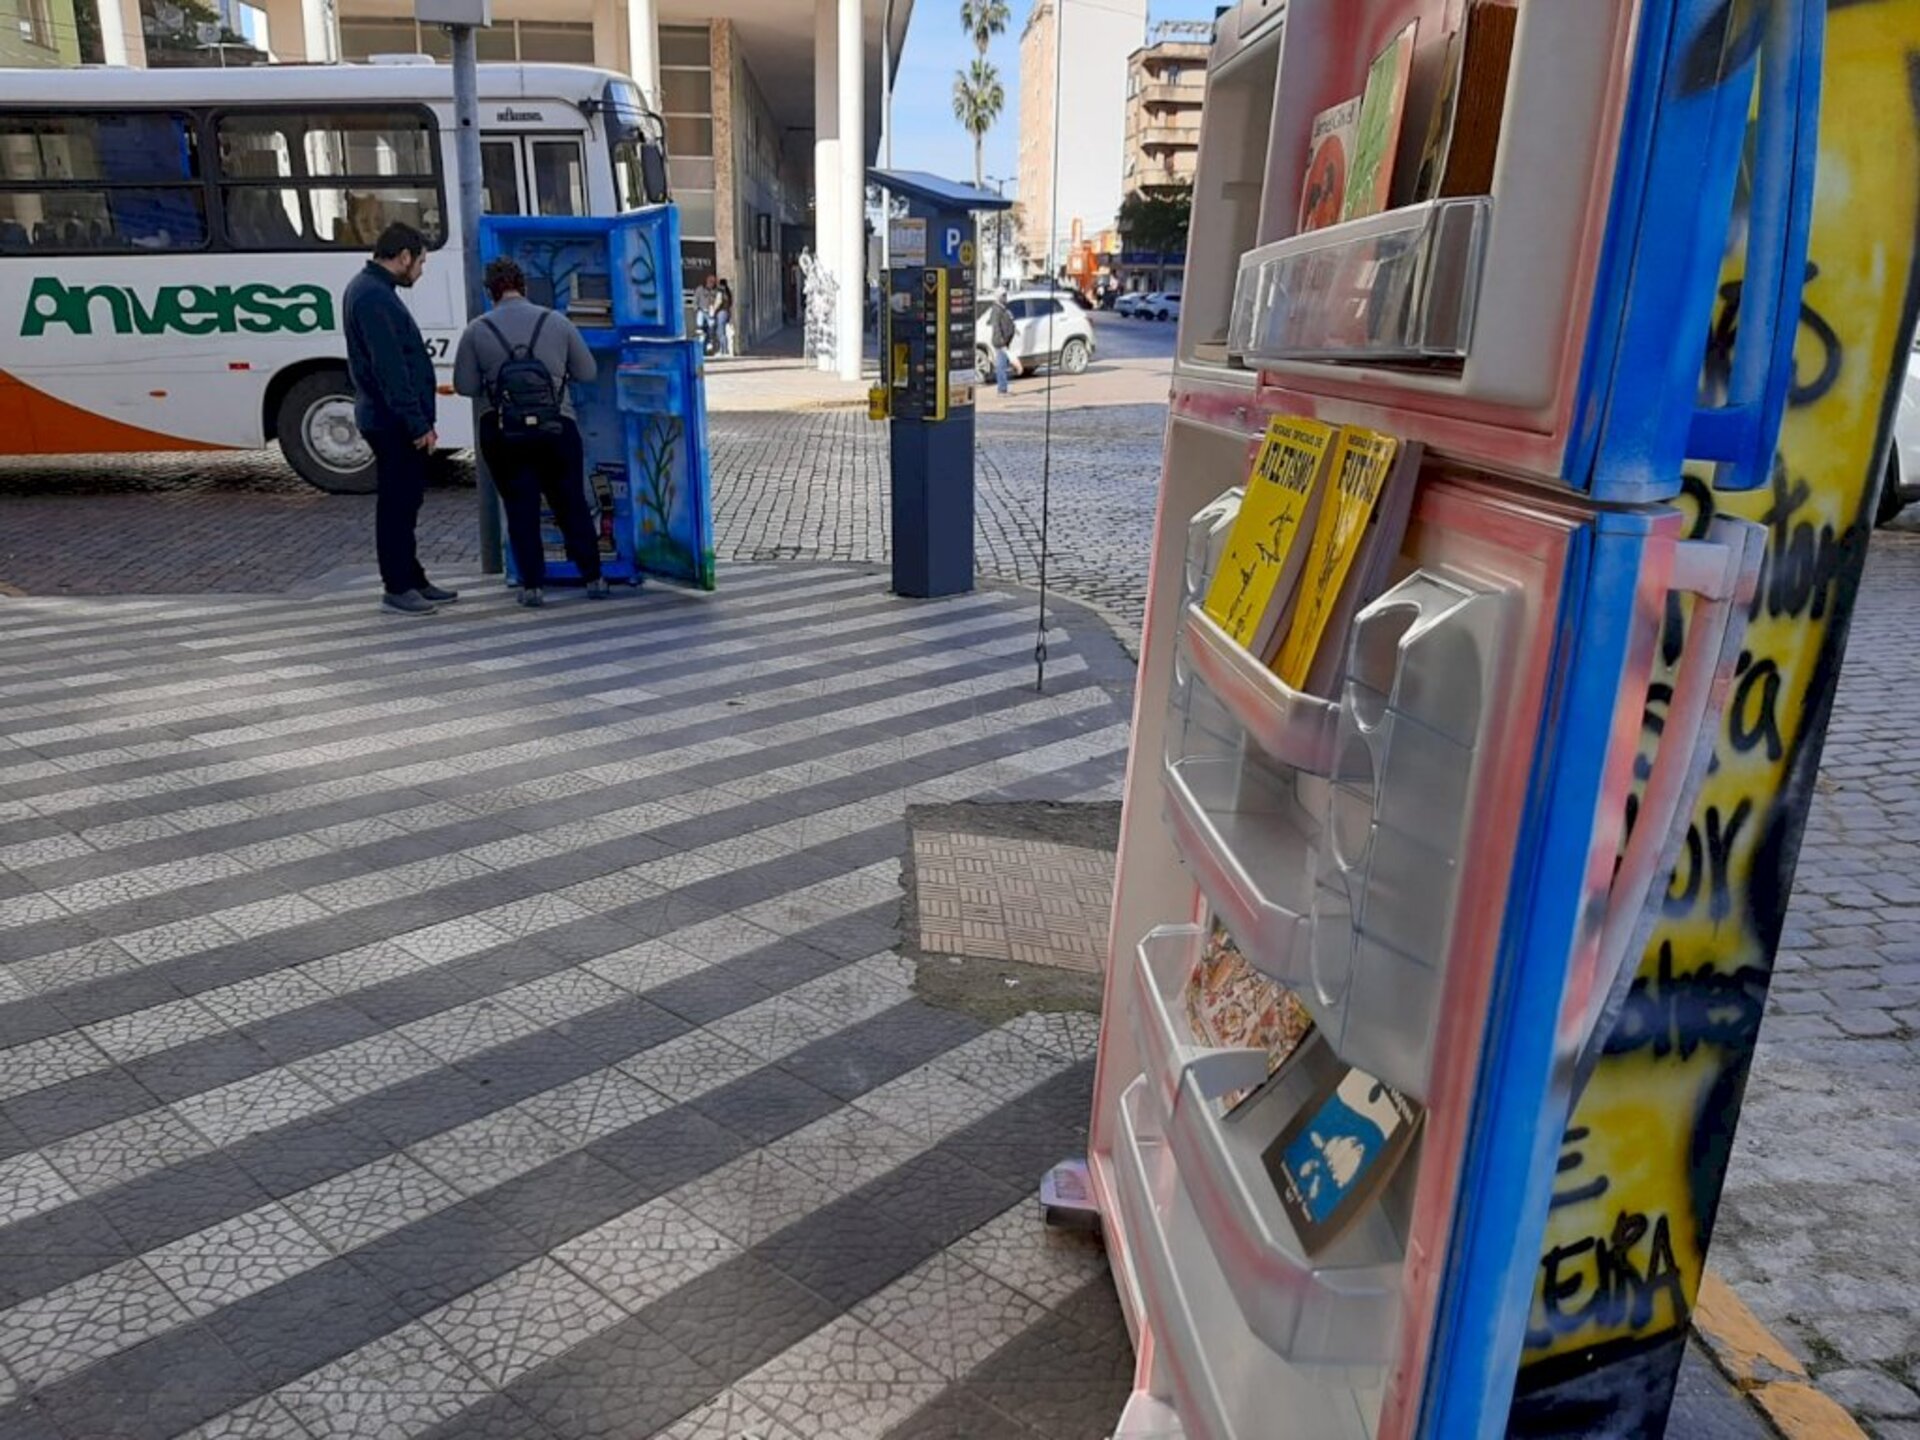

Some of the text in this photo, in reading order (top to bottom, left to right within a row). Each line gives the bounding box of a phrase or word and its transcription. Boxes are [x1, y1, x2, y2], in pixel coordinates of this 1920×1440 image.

[946, 228, 960, 255] P
[20, 277, 335, 336] Anversa
[1259, 440, 1316, 494] ATLETISMO
